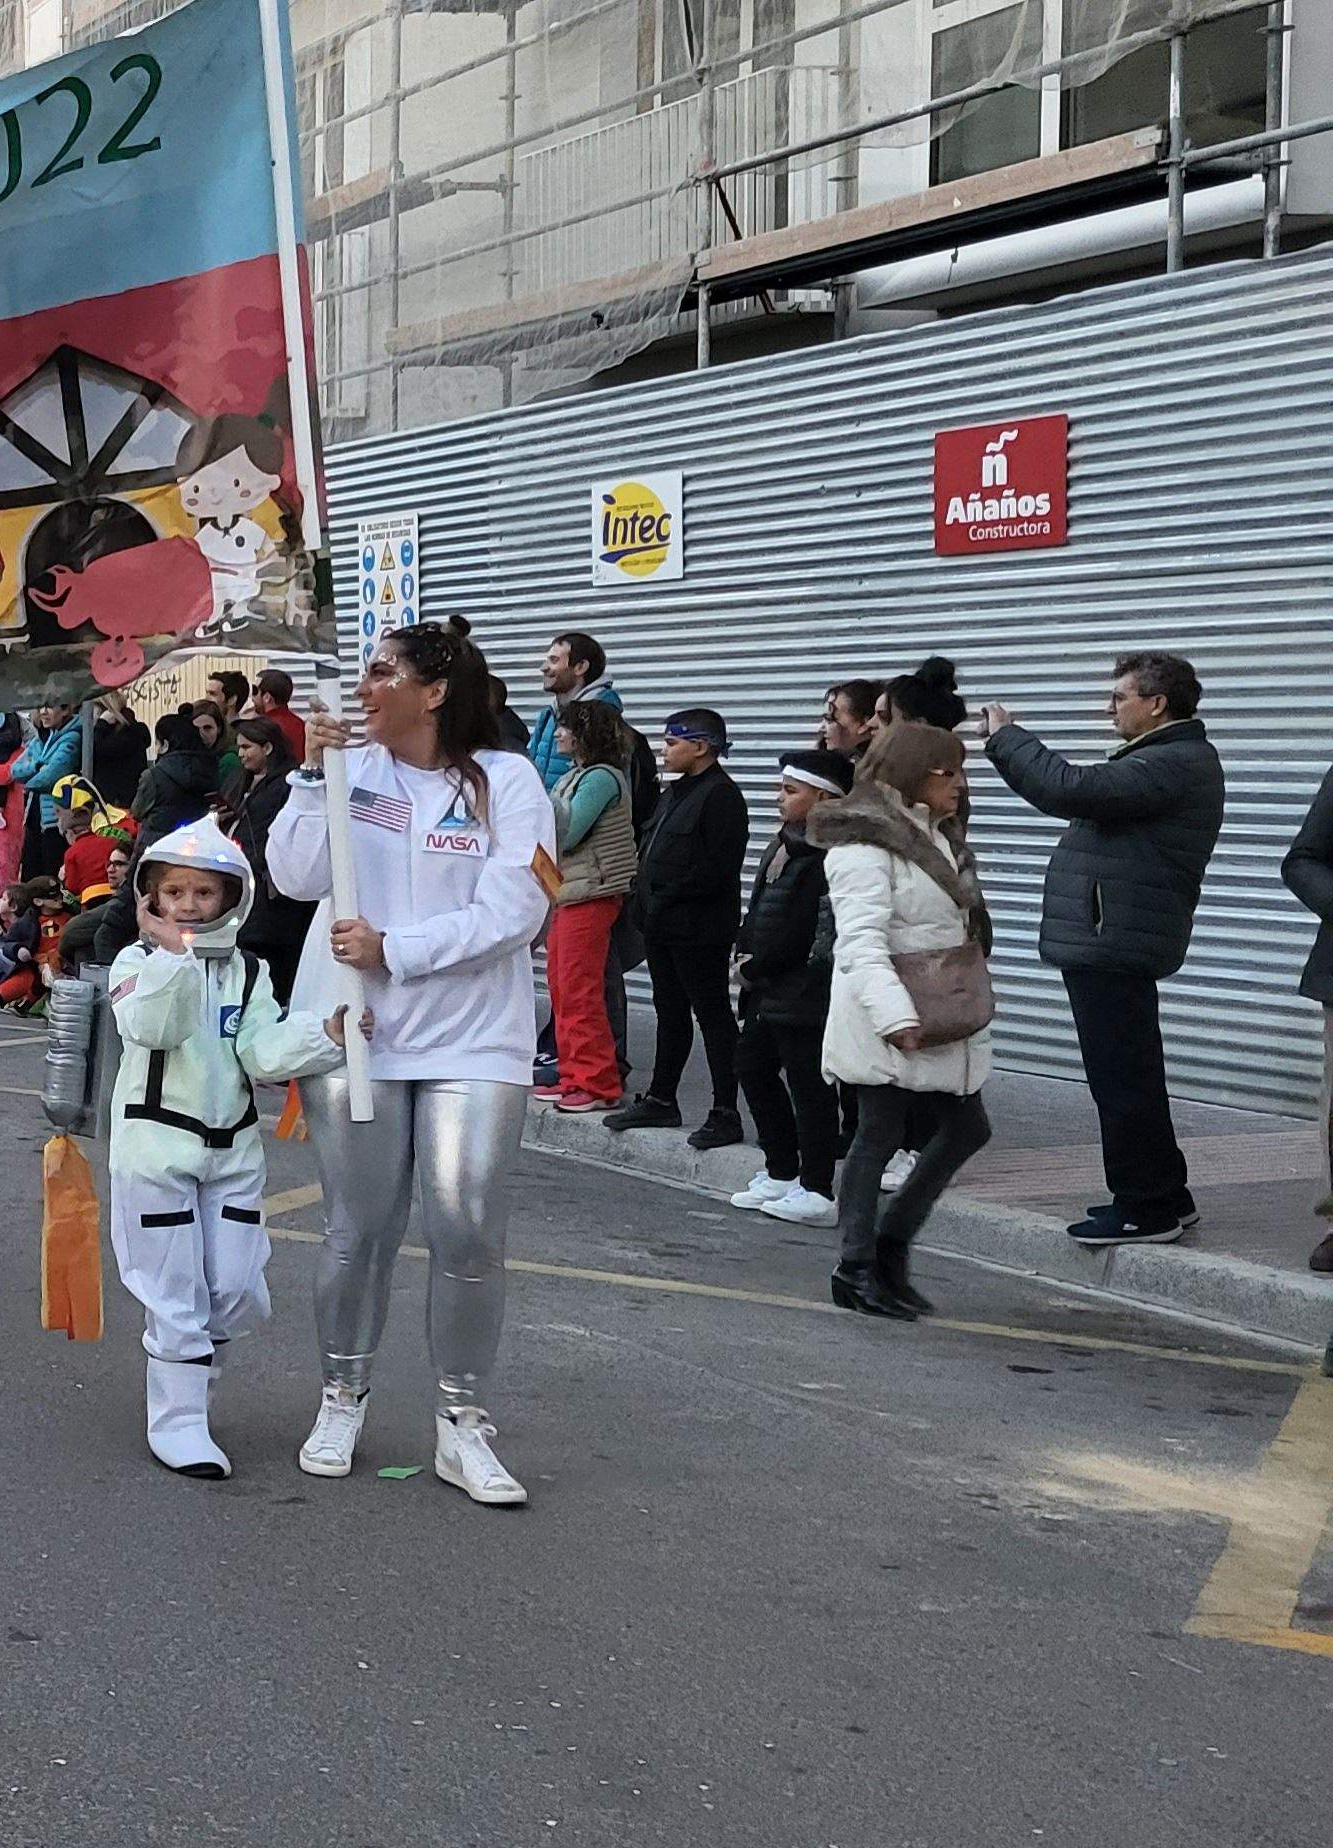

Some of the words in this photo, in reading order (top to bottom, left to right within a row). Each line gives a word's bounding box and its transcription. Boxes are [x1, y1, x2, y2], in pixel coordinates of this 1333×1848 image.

[945, 488, 1051, 525] Añaños
[968, 520, 1051, 541] Constructora
[426, 834, 480, 852] NASA
